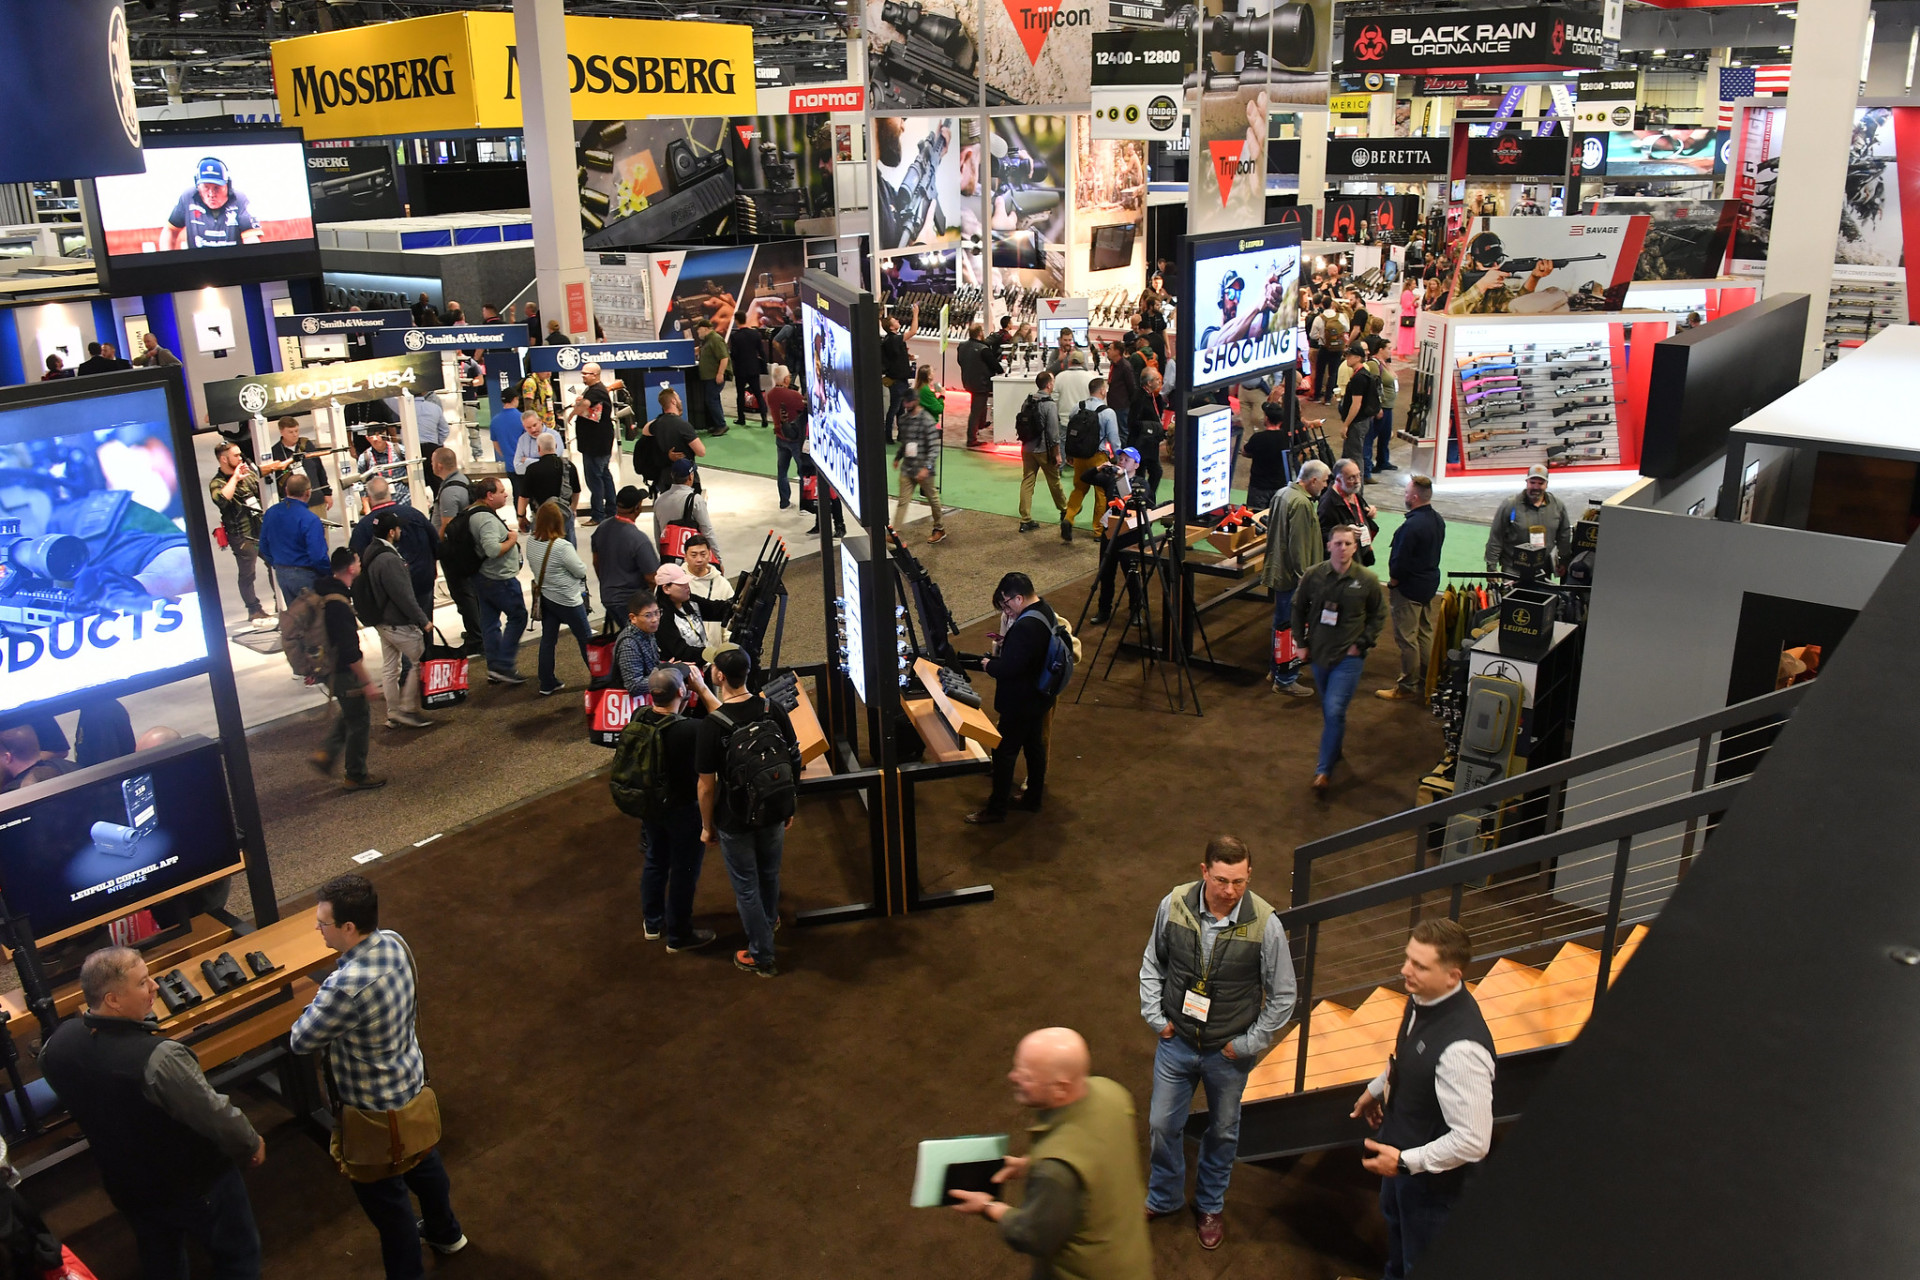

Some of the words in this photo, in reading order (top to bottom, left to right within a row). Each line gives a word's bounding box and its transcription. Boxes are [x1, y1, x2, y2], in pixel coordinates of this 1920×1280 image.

[1020, 6, 1091, 34] Trijicon
[1390, 24, 1469, 45] BLACK
[1476, 22, 1536, 41] RAIN
[1565, 23, 1594, 44] BLACK
[1096, 51, 1133, 65] 12400
[1143, 50, 1181, 64] 12800
[1411, 41, 1511, 56] ORDNANCE
[291, 53, 456, 117] MOSSBERG
[795, 92, 858, 108] norma
[1147, 107, 1177, 116] BRIDGE
[1219, 155, 1256, 180] Trijicon
[1370, 150, 1431, 164] BERETTA
[1688, 209, 1716, 217] SAVAGE
[1585, 226, 1619, 235] SAVAGE
[581, 349, 669, 363] Smith&Wesson
[1202, 328, 1291, 374] SHOOTING
[274, 378, 364, 404] MODEL
[367, 366, 416, 390] 1854
[0, 596, 184, 673] DUCTS
[1503, 623, 1538, 636] LEUPOLD
[69, 879, 116, 902] LEUPOLD
[115, 862, 160, 885] CONTROL
[159, 855, 179, 870] APP
[107, 874, 147, 895] INTERFACE
